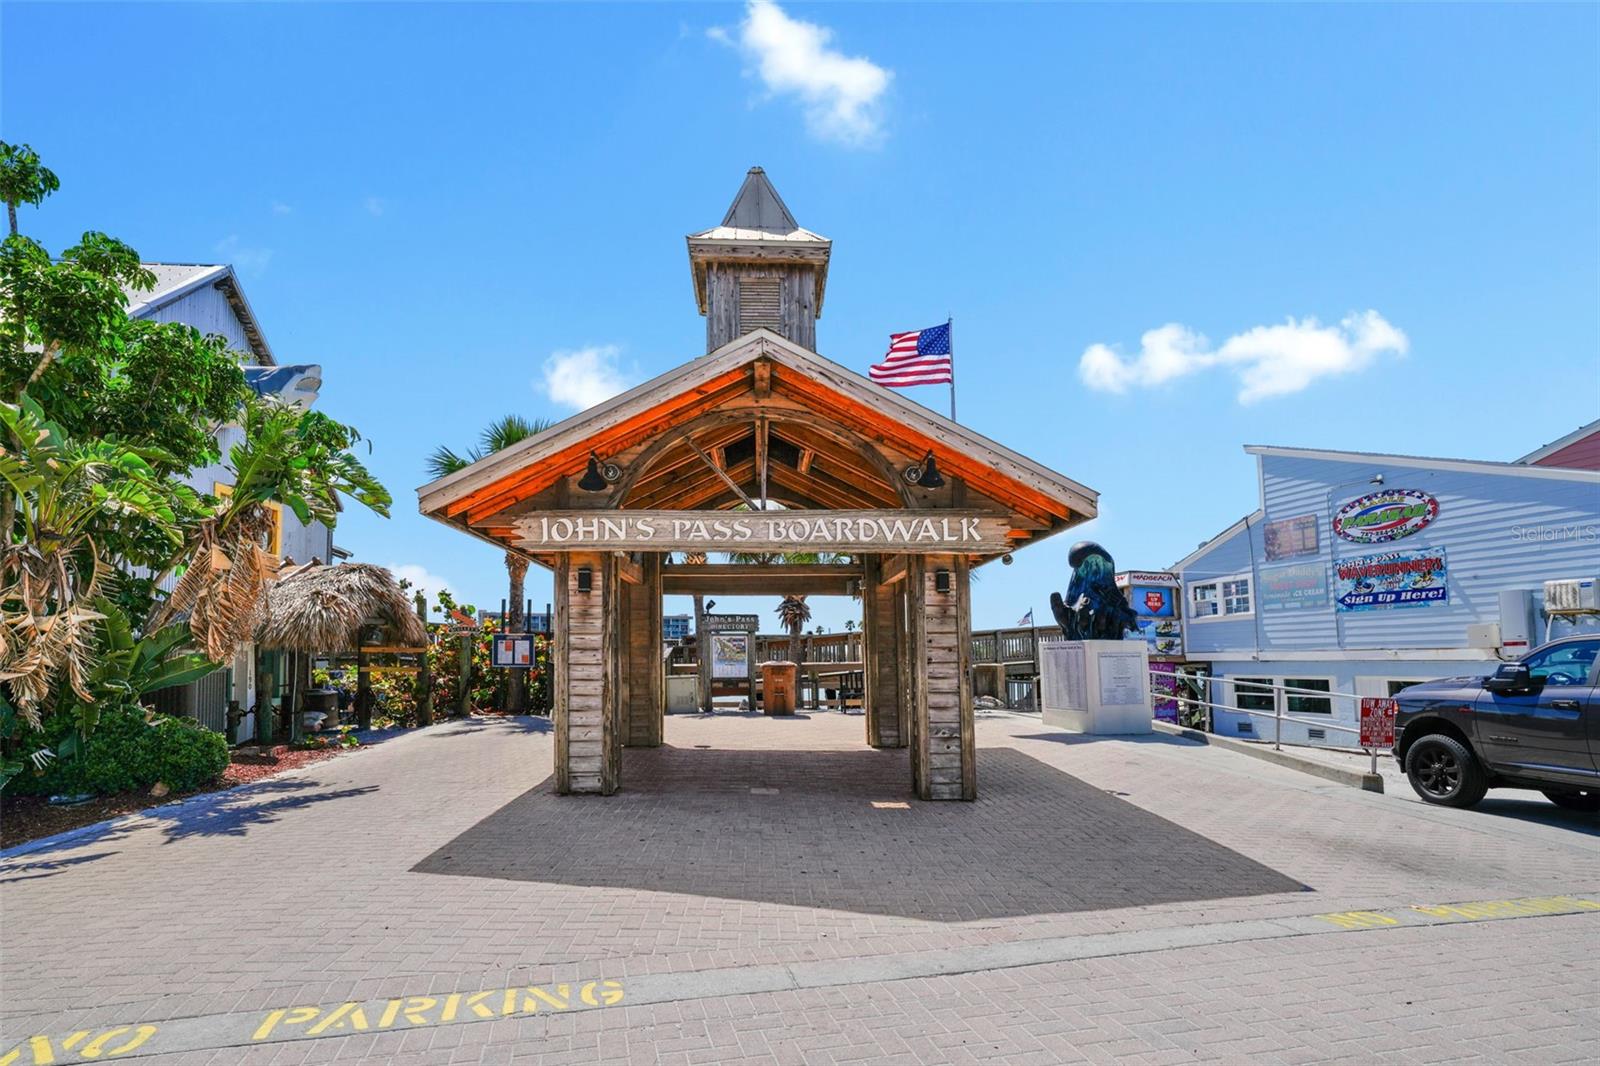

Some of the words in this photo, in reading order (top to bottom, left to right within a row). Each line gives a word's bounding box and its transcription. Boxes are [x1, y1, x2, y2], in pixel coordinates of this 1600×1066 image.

[540, 517, 656, 544] JOHN'S
[672, 517, 752, 542] PASS
[766, 517, 982, 542] BOARDWALK
[1344, 594, 1374, 605] Sign
[1378, 593, 1396, 603] Up
[1400, 588, 1445, 600] Here!
[251, 981, 625, 1040] PARKING
